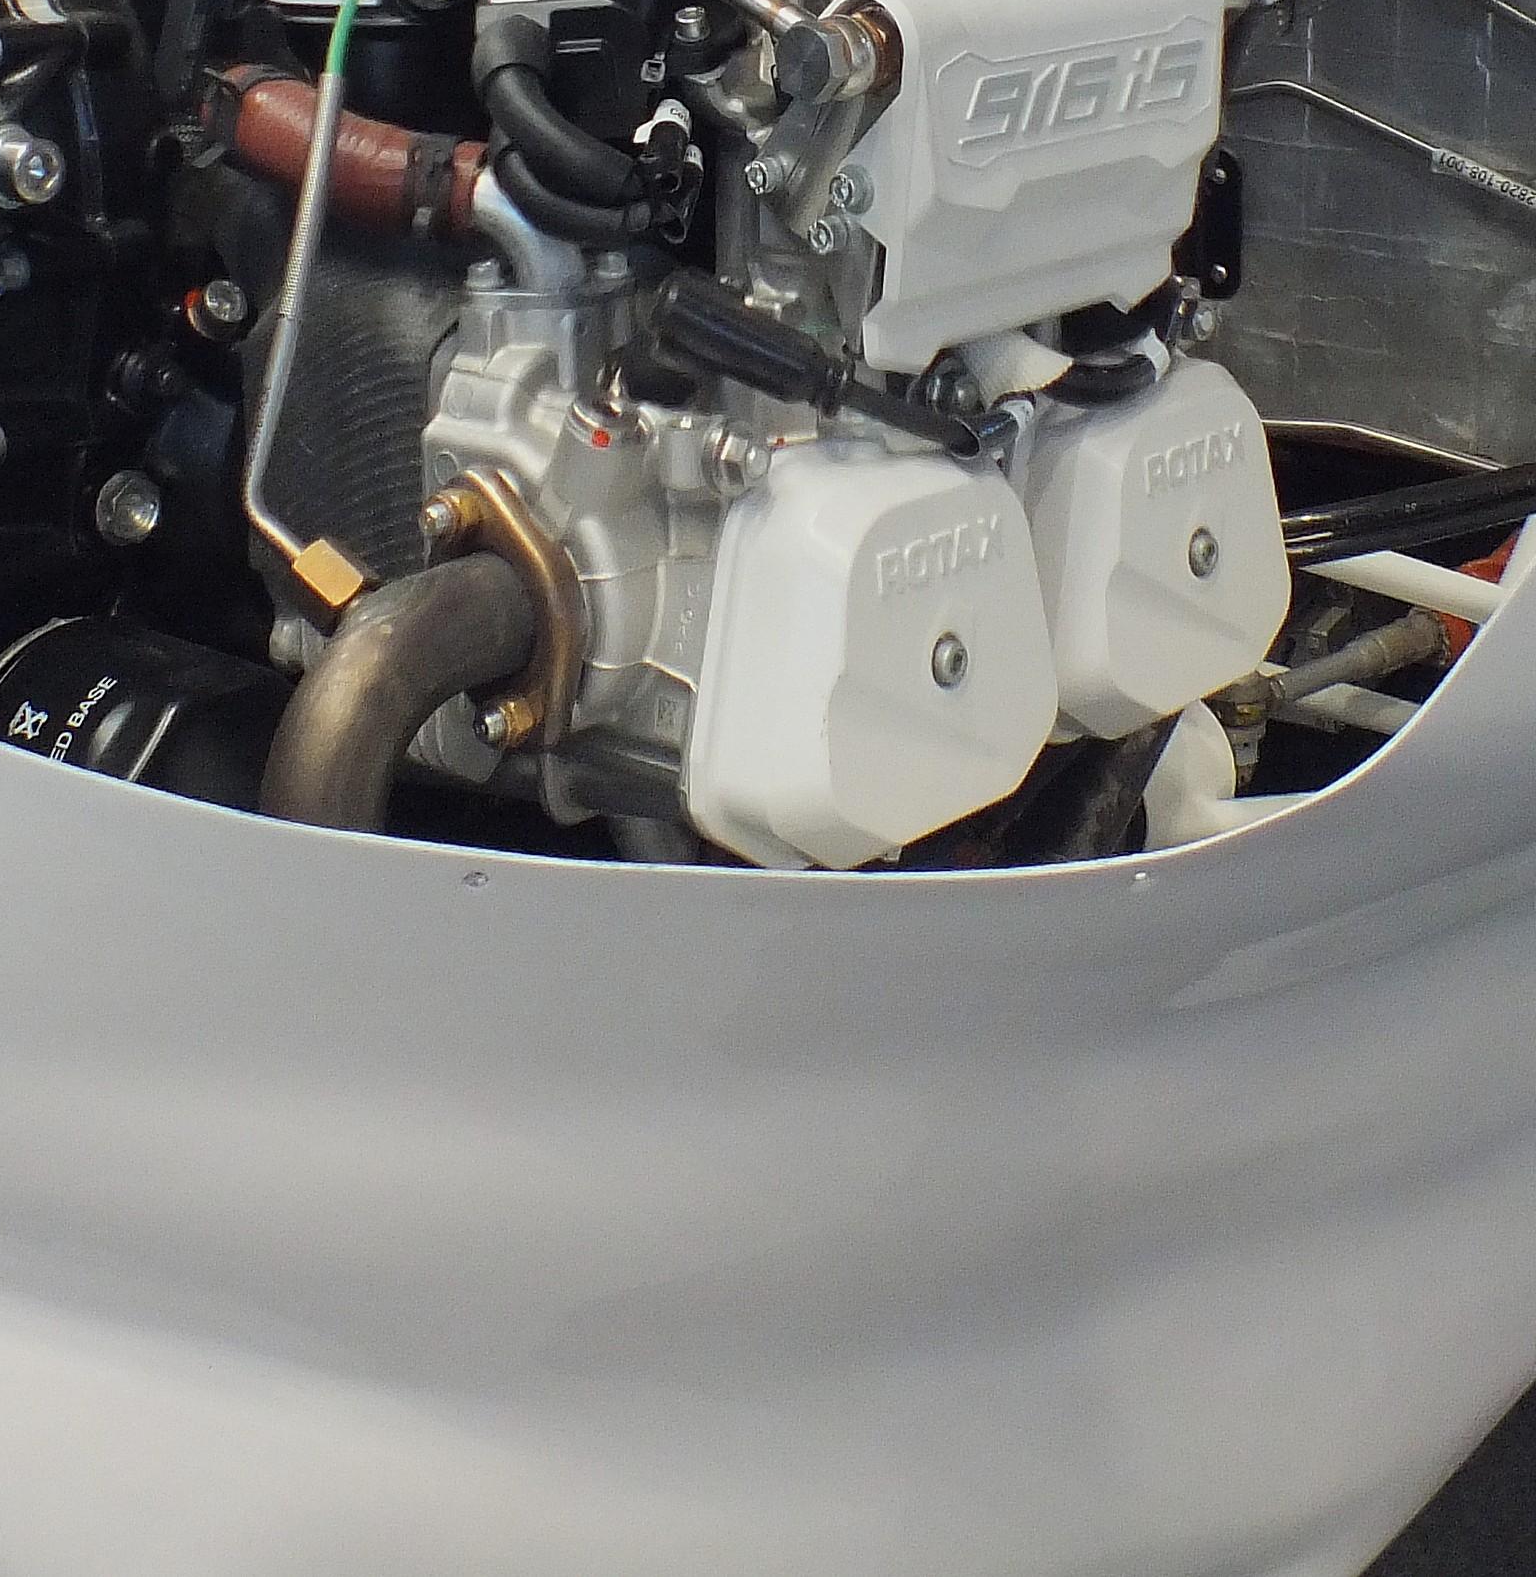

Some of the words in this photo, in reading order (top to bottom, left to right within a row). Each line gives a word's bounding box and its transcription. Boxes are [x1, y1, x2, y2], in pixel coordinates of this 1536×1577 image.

[958, 54, 1120, 155] 916
[1141, 421, 1247, 498] ROTAX
[873, 510, 1007, 598] ROTAX
[66, 675, 118, 728] BASE
